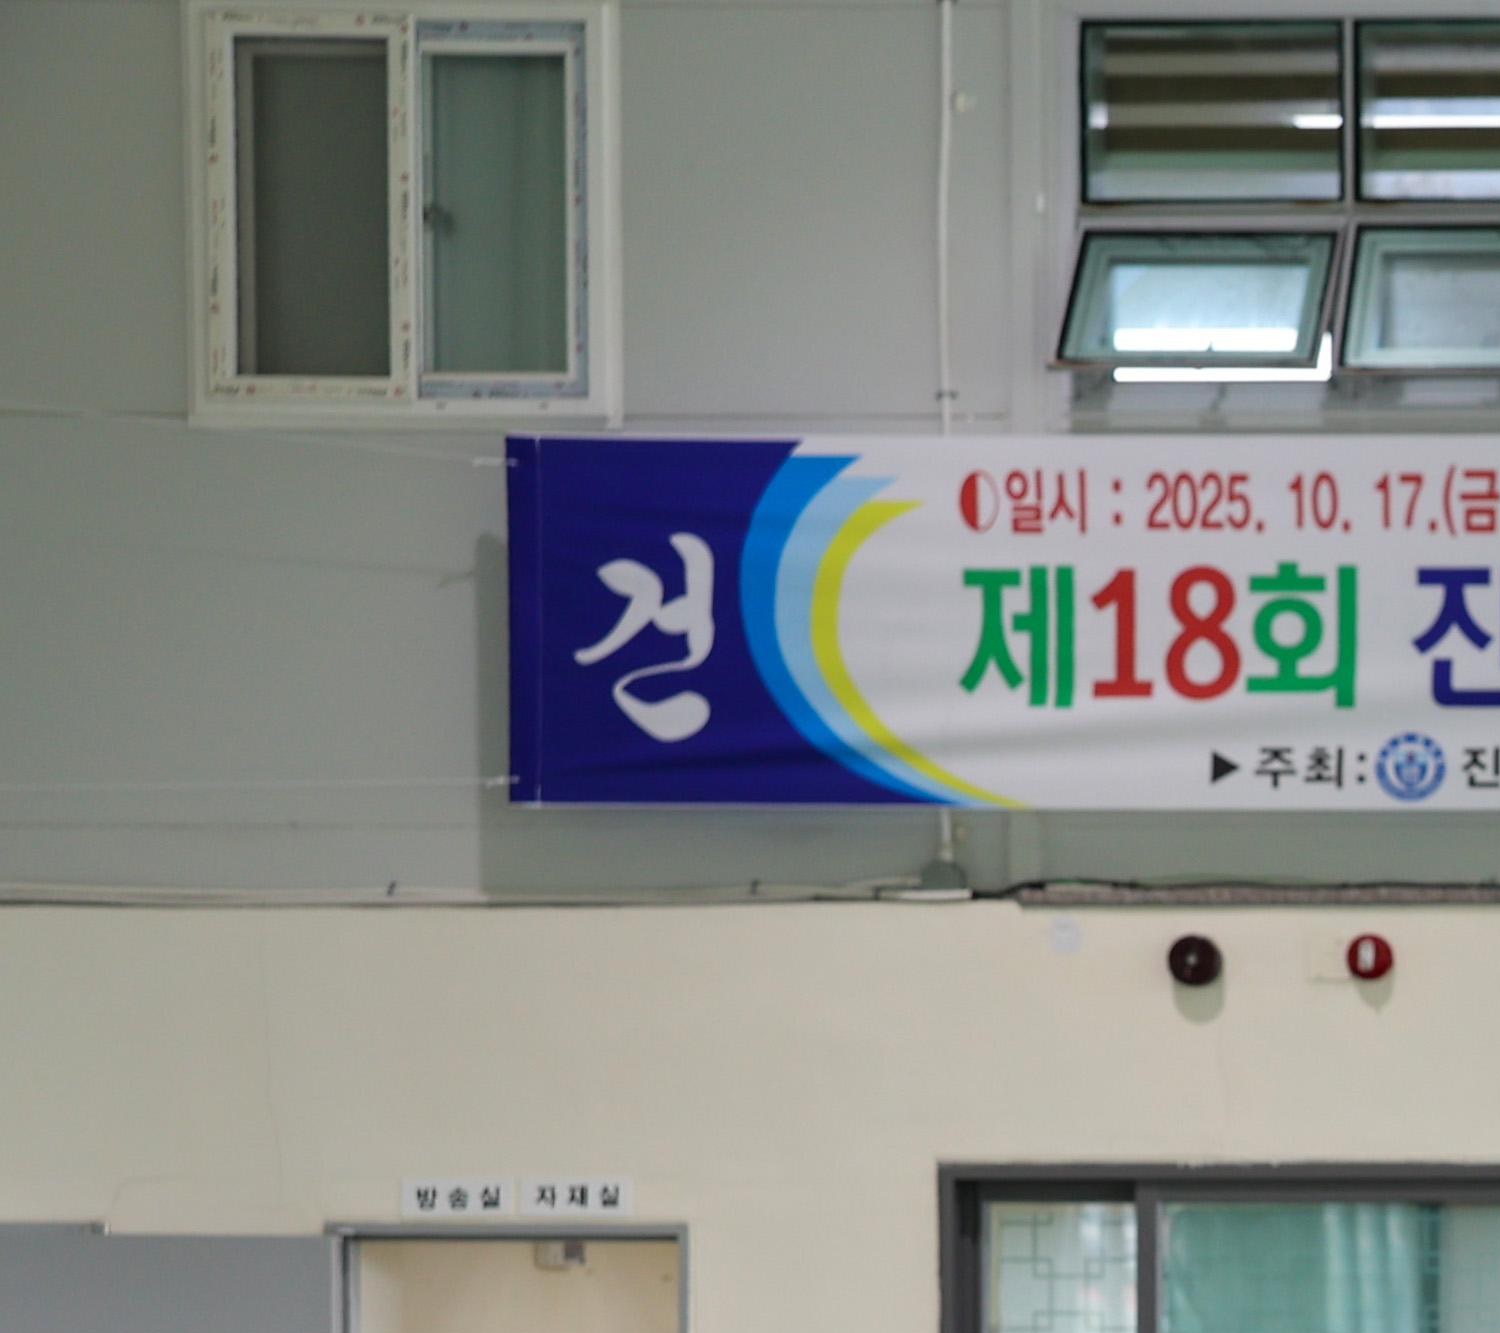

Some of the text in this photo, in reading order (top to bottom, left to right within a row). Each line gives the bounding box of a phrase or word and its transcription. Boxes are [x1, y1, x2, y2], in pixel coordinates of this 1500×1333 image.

[1006, 471, 1085, 532] 일시
[1147, 472, 1264, 532] 2025.
[1290, 473, 1350, 531] 10.
[960, 562, 1357, 708] 제18회
[1257, 749, 1366, 787] 주최:
